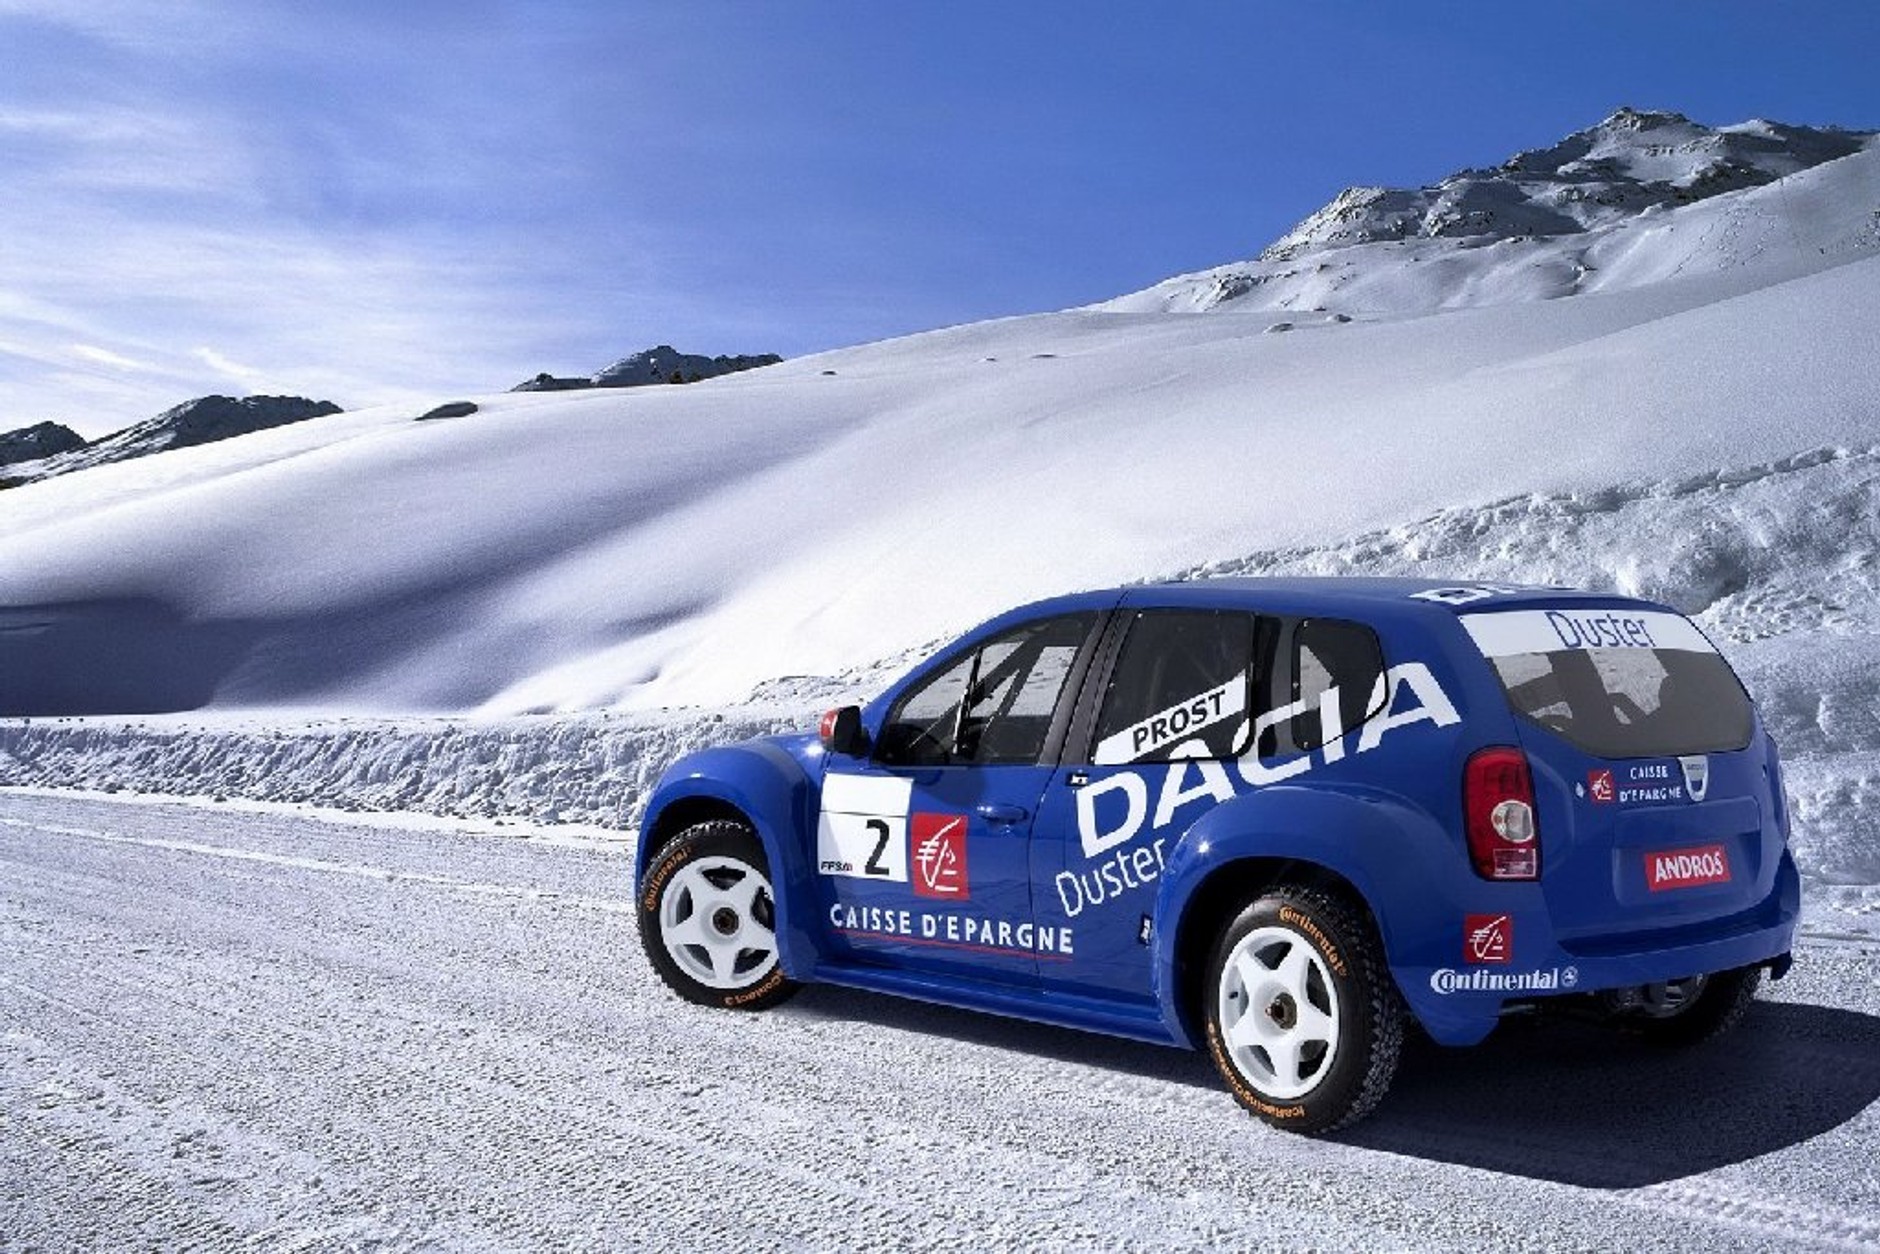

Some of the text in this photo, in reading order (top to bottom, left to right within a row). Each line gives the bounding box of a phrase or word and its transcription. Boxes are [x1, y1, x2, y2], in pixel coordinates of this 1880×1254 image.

[1545, 610, 1657, 648] Duster
[1132, 690, 1226, 753] PROST
[1076, 662, 1462, 859] DACIA
[1630, 765, 1669, 780] CAISSE
[1619, 785, 1682, 803] D'EPARGNE
[864, 818, 891, 876] 2
[1655, 851, 1724, 883] ANDROS
[1054, 837, 1168, 918] Duster
[829, 902, 1075, 954] CAISSE D'EPARGNE
[1279, 904, 1346, 972] Continental
[1430, 966, 1559, 995] Continental
